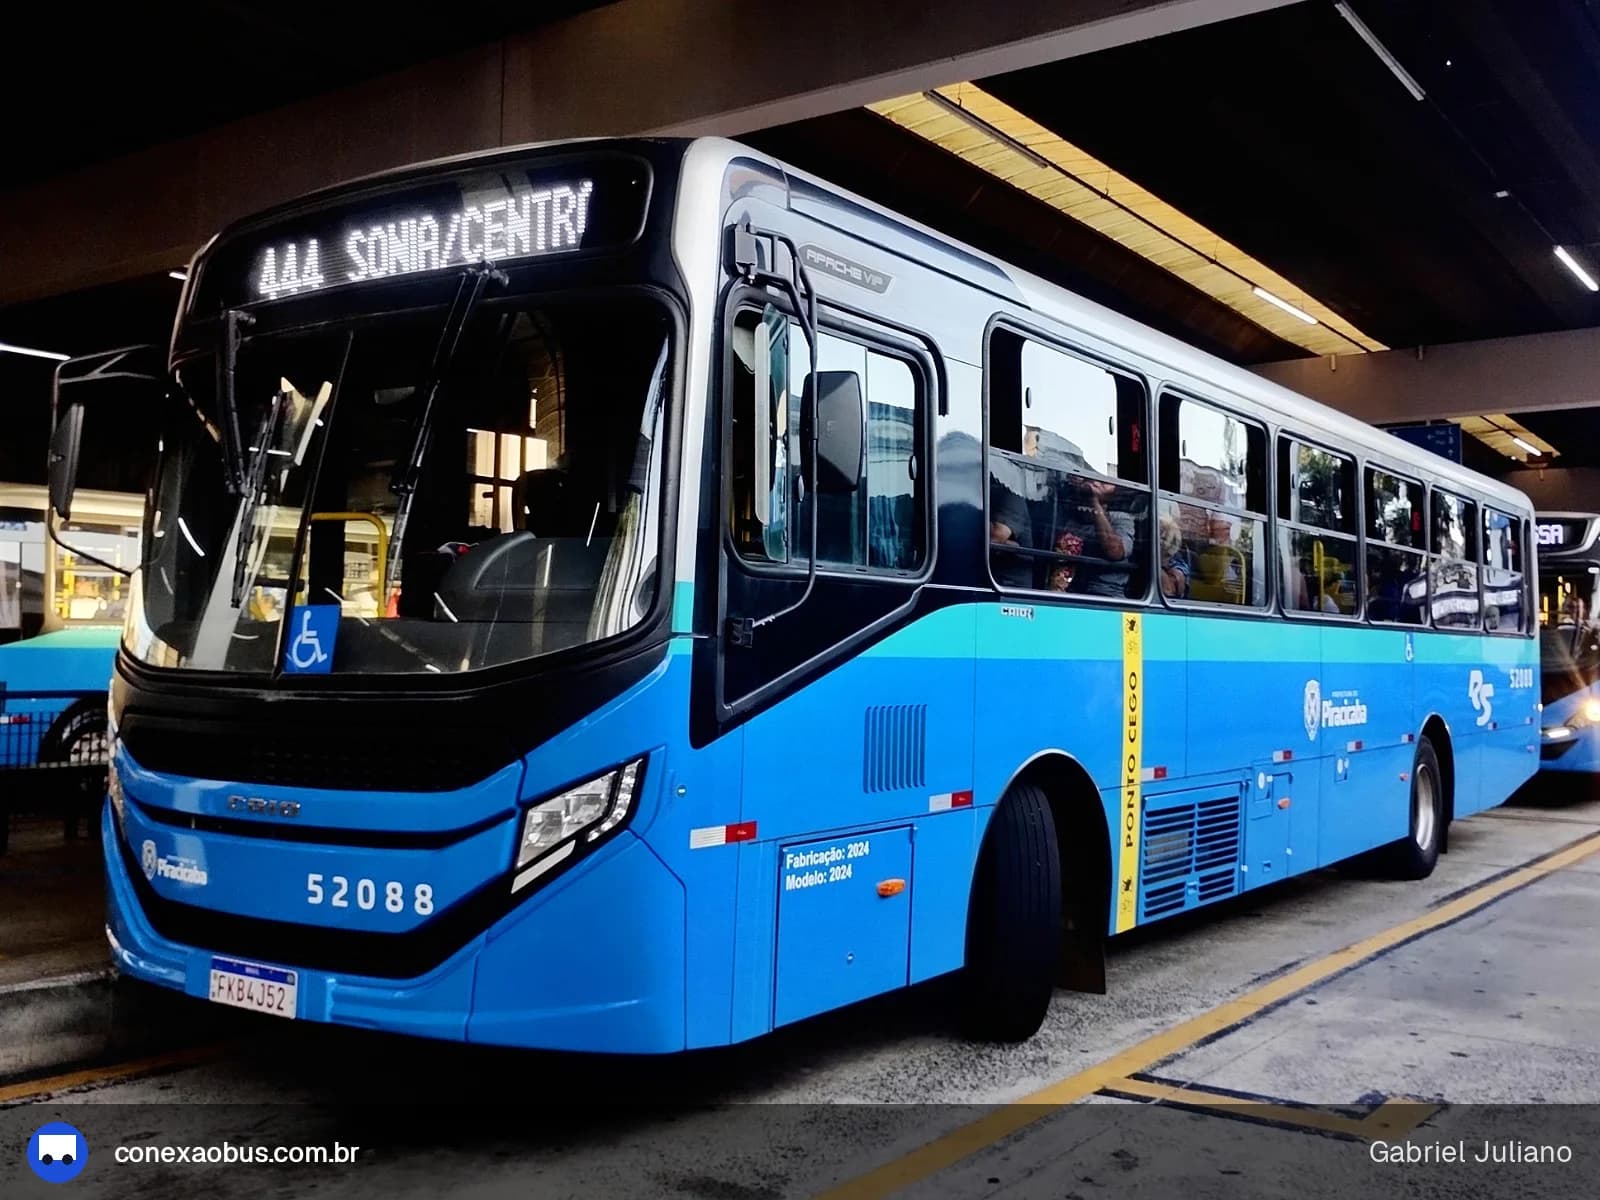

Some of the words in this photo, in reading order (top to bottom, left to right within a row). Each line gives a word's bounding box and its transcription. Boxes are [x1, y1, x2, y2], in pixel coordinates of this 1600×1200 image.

[259, 239, 324, 300] 444
[806, 248, 862, 281] APACHE
[1128, 671, 1138, 743] CEGO
[1125, 753, 1136, 848] PONTO
[785, 846, 846, 870] Fabricação:
[847, 840, 870, 859] 2024
[307, 873, 434, 916] 52088
[785, 869, 828, 892] Modelo:
[829, 863, 852, 883] 2024
[217, 974, 286, 1011] FKB4J52
